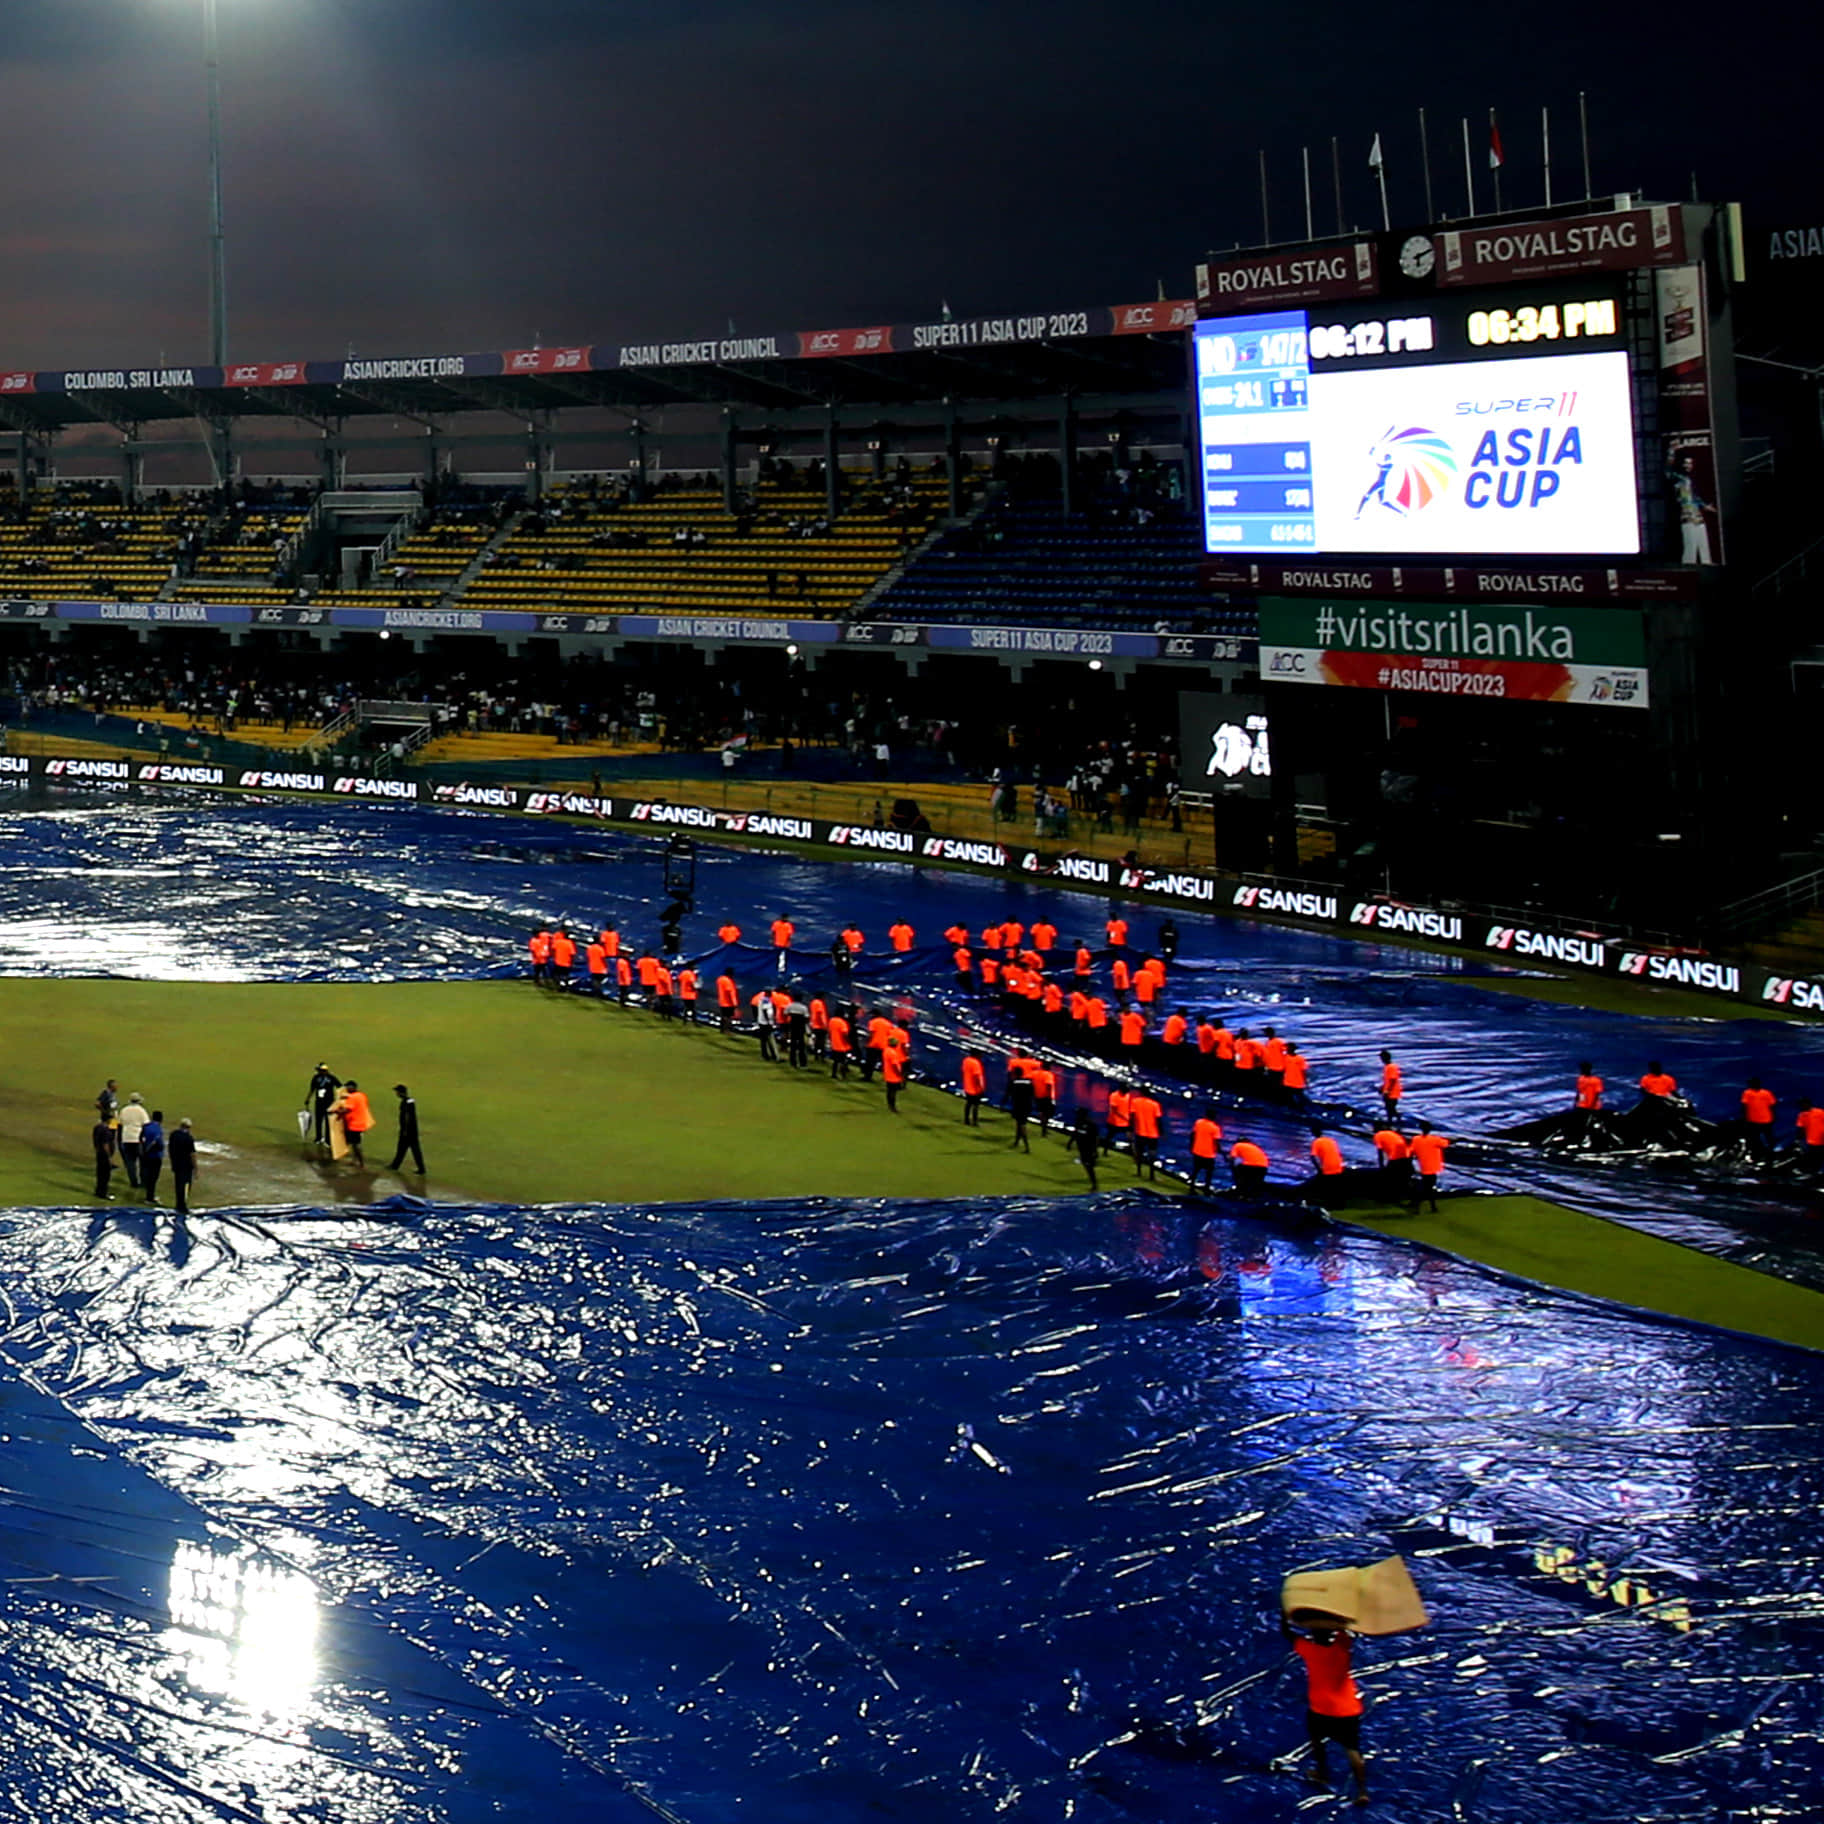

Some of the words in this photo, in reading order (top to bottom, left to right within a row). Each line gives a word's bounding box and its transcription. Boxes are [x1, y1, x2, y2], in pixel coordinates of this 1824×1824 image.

[1770, 227, 1824, 260] ASIA
[913, 321, 979, 348] SUPER11
[982, 318, 1014, 343] ASIA
[1018, 316, 1047, 340] CUP
[1050, 313, 1088, 337] 2023
[1387, 317, 1433, 352] PM
[1468, 305, 1559, 345] 06:34
[1563, 300, 1615, 337] PM
[620, 346, 659, 367] ASIAN
[662, 342, 717, 365] CRICKET
[720, 338, 779, 361] COUNCIL
[65, 372, 127, 391] COLOMBO,
[130, 371, 150, 388] SRI
[154, 370, 193, 387] LANKA
[343, 357, 464, 380] ASIANCRICKET.ORG
[1456, 398, 1554, 415] SUPER
[1558, 392, 1578, 416] 11
[1472, 427, 1583, 467] ASIA
[1464, 470, 1560, 510] CUP
[155, 605, 170, 619] SRI
[173, 606, 206, 620] LANKA
[385, 611, 481, 629] ASIANCRICKET.ORG
[657, 619, 693, 636] ASIAN
[695, 620, 743, 638] CRICKET
[744, 622, 790, 640] COUNCIL
[1316, 606, 1573, 659] #visitsrilanka
[971, 630, 1023, 649] SUPER11
[1026, 632, 1052, 651] ASIA
[1054, 633, 1078, 653] CUP
[1080, 634, 1112, 654] 2023
[1378, 668, 1504, 697] #ASIACUP2023
[1615, 680, 1639, 691] ASIA
[1614, 691, 1634, 701] CUP
[66, 761, 128, 778] SANSUI
[160, 765, 223, 784] SANSUI
[260, 772, 323, 790] SANSUI
[355, 778, 416, 797] SANSUI
[748, 816, 811, 839] SANSUI
[851, 827, 913, 852] SANSUI
[1259, 887, 1336, 920] SANSUI
[1378, 905, 1462, 940] SANSUI
[1515, 929, 1604, 967] SANSUI
[1649, 955, 1739, 992] SANSUI
